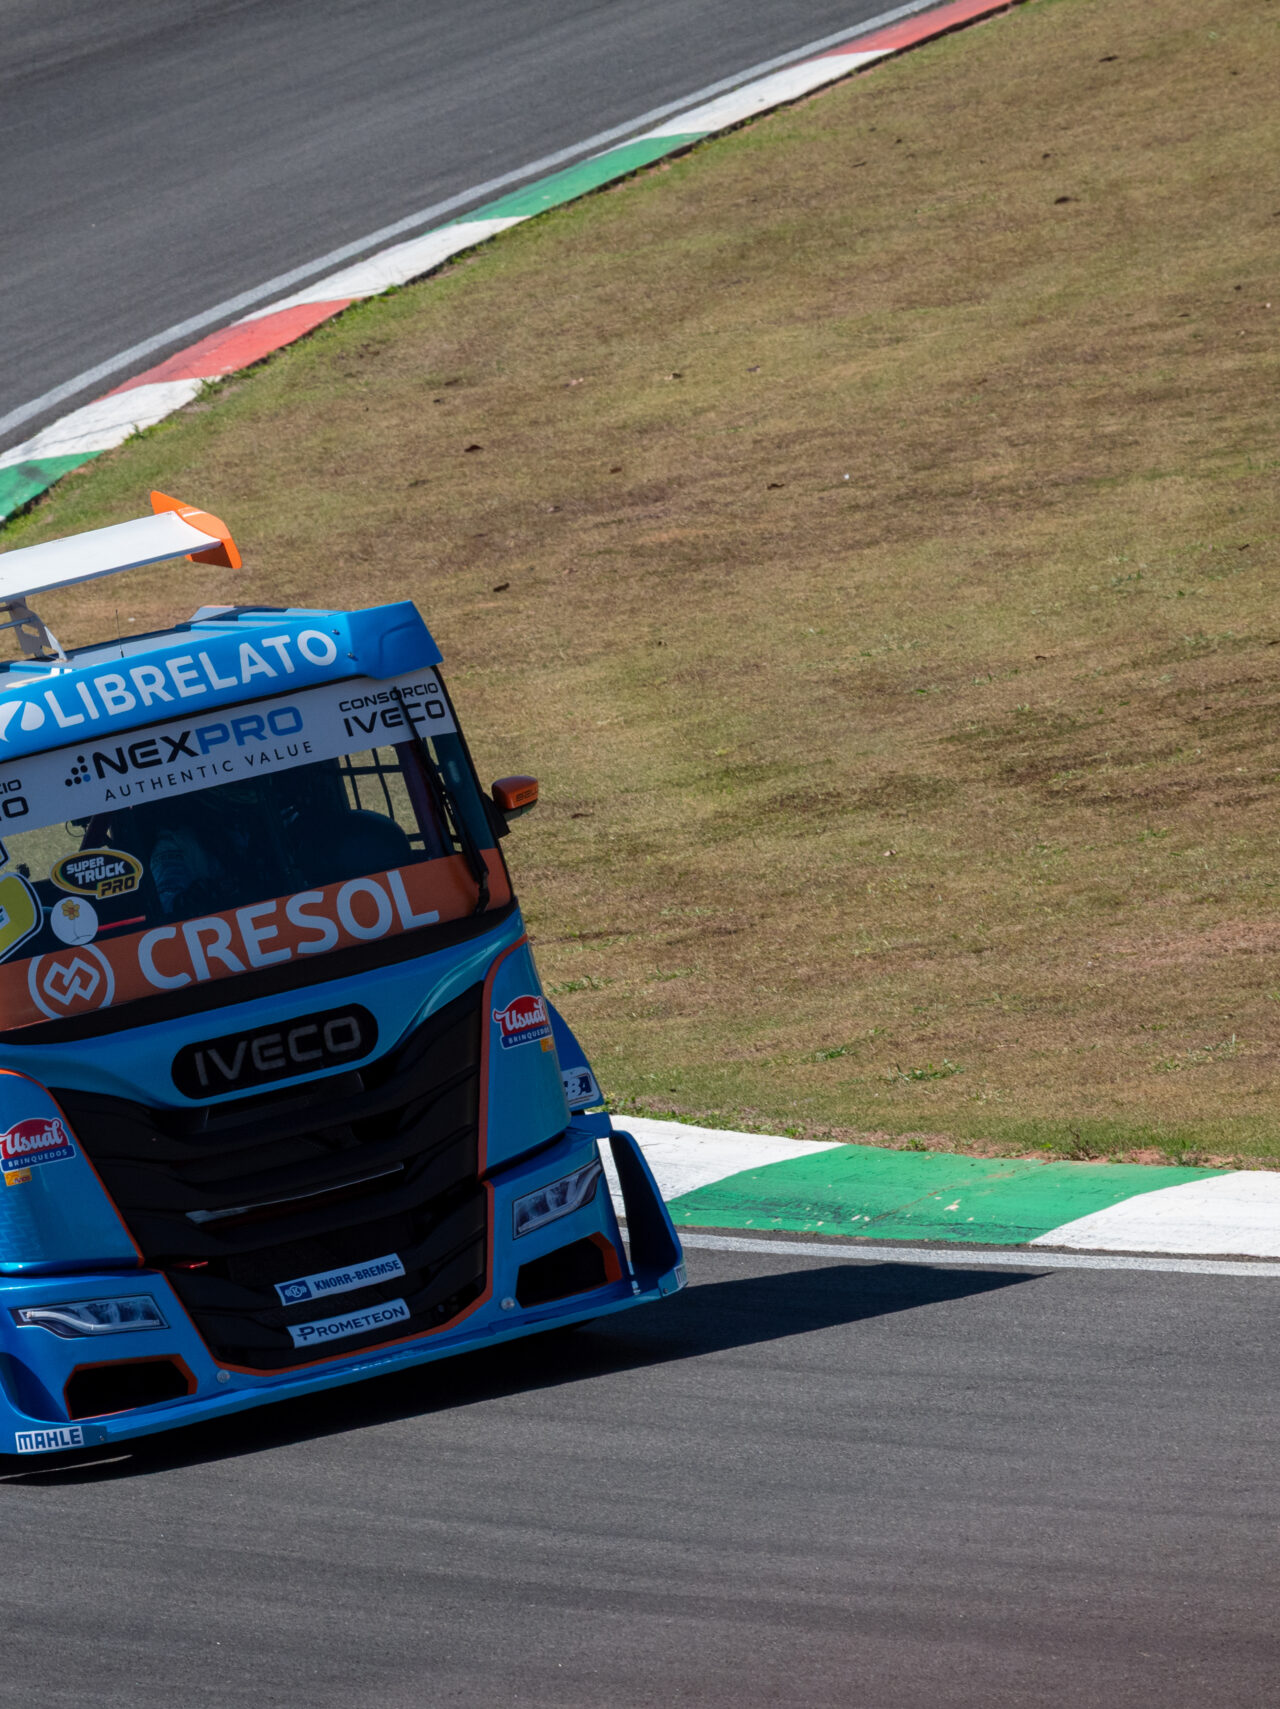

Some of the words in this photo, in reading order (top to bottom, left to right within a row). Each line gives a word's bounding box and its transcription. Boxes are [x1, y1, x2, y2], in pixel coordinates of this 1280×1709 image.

[44, 629, 338, 729] LIBRELATO
[338, 682, 439, 713] CONSÓRCIO
[343, 700, 446, 737] IVECO
[92, 706, 304, 780] NEXPRO
[104, 760, 234, 802] AUTHENTIC
[244, 741, 313, 767] VALUE
[66, 856, 105, 875] SUPER
[75, 861, 125, 885] TRUCK
[101, 875, 135, 896] PRO
[136, 869, 439, 990] CRESOL
[495, 998, 546, 1031] Usual
[194, 1015, 363, 1088] IVECO
[7, 1149, 68, 1168] BRINQUEDOS
[314, 1259, 402, 1292] KNORR-BREMSE
[296, 1306, 406, 1341] PROMETEON
[17, 1428, 82, 1450] MAHLE
